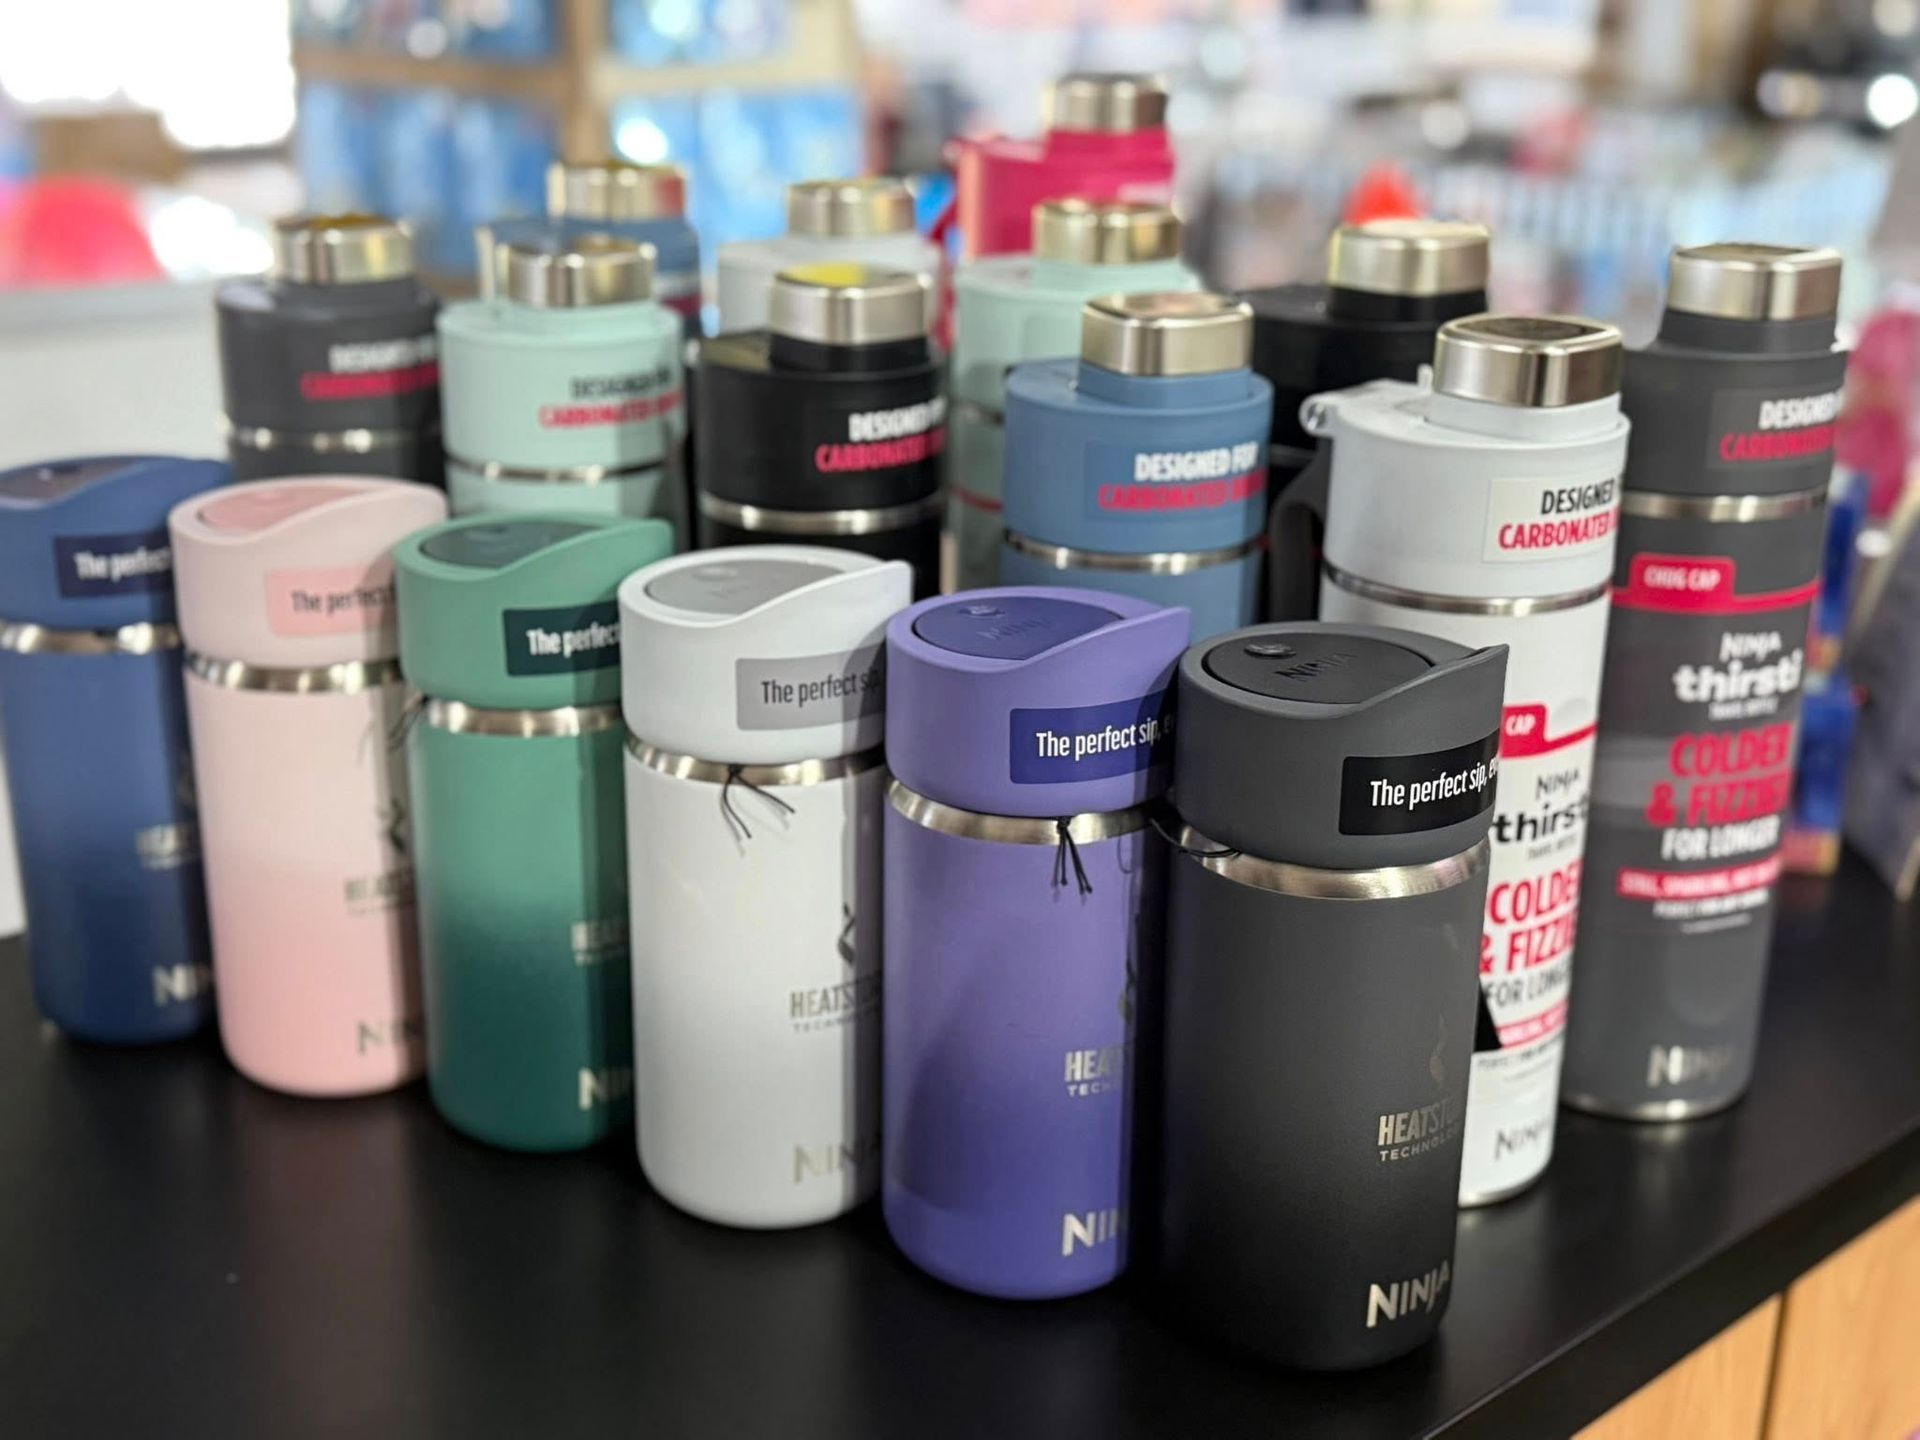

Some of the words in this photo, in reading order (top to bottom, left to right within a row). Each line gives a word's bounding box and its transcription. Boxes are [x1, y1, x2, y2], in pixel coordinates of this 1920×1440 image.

[1134, 447, 1231, 482] DESIGNED
[73, 551, 109, 580] The
[526, 627, 561, 656] The
[761, 680, 794, 705] The
[797, 674, 858, 708] perfect
[1036, 731, 1070, 757] The
[1074, 725, 1137, 762] perfect
[1370, 779, 1405, 806] The
[1408, 771, 1467, 811] perfect
[1469, 761, 1487, 793] sip,
[1645, 781, 1677, 827] &
[1661, 826, 1708, 861] FOR
[1366, 1259, 1450, 1328] NINJA
